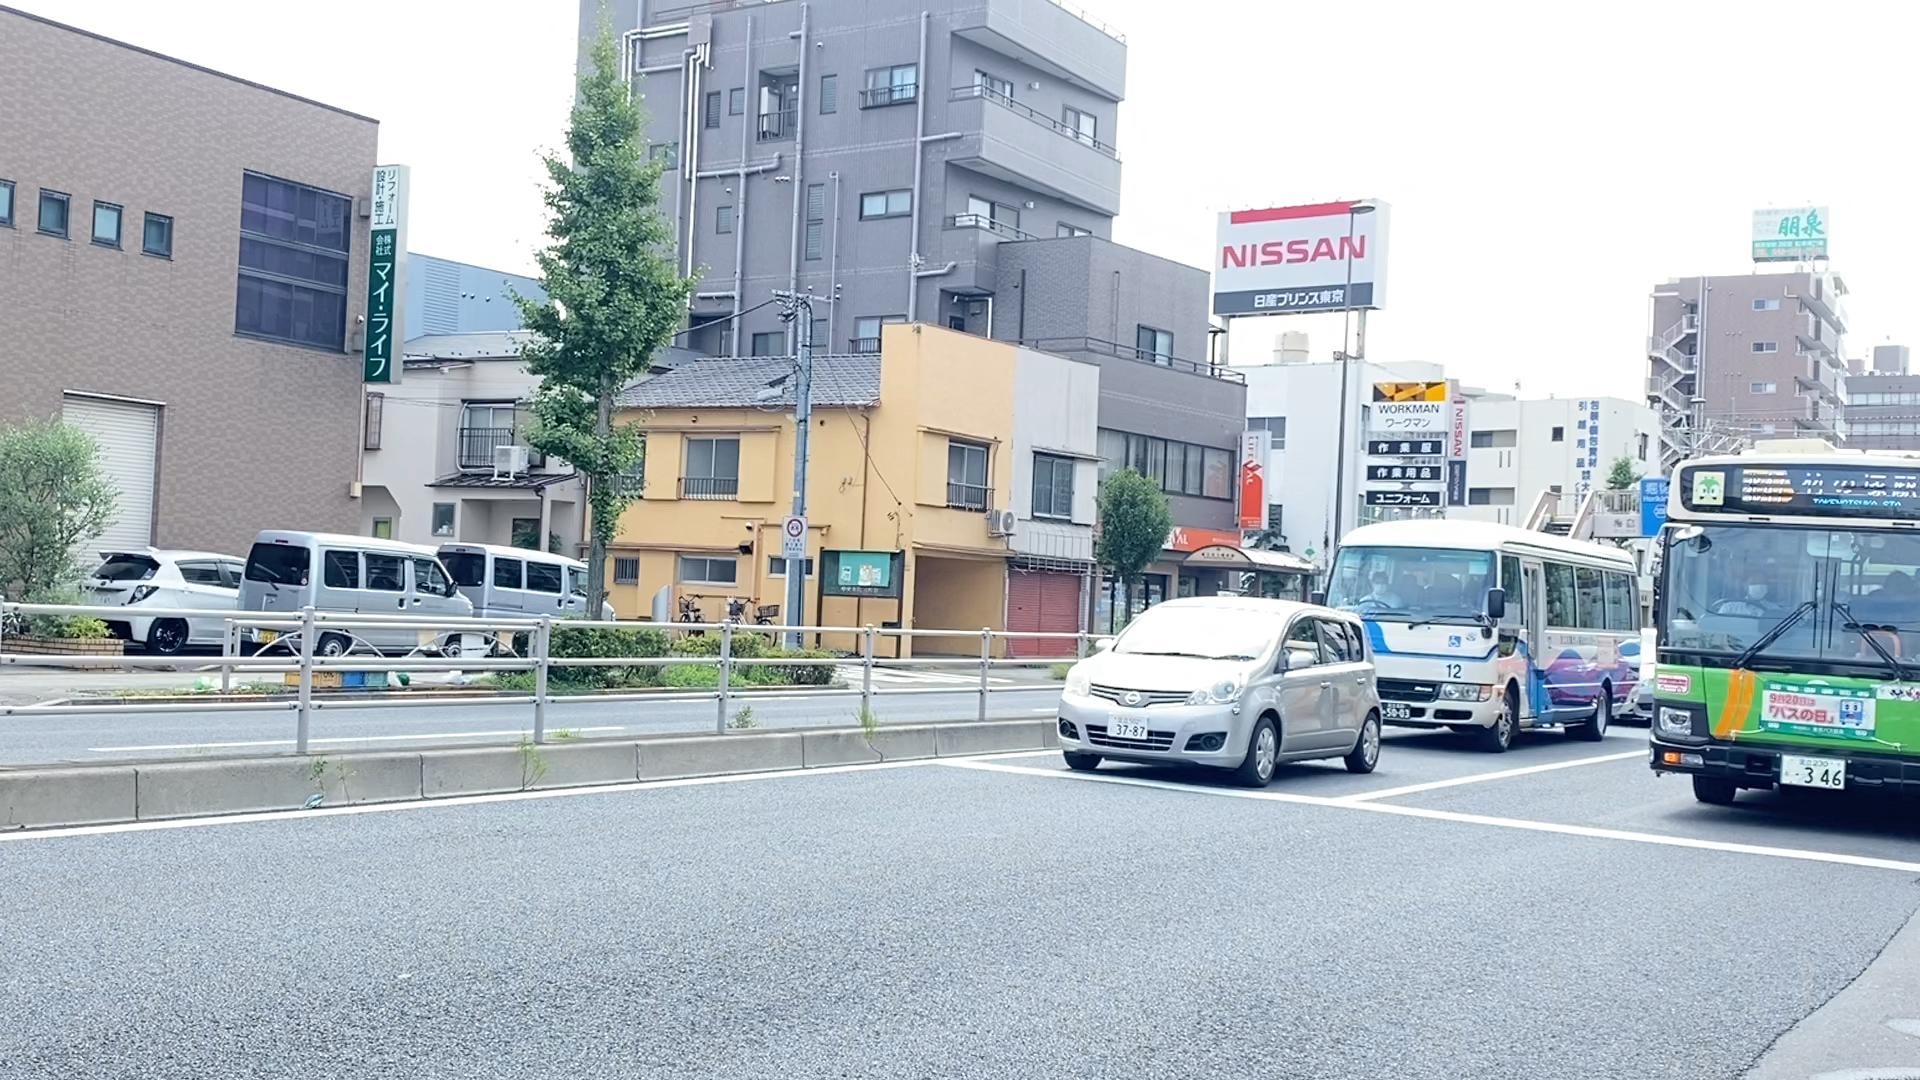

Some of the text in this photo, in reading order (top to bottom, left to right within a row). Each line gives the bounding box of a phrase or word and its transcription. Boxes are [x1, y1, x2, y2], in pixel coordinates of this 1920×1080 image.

[374, 169, 386, 225] 設計・施工
[385, 169, 396, 225] リフォーム
[1778, 208, 1825, 237] 朋泉
[1222, 235, 1365, 269] NISSAN
[1254, 289, 1344, 308] 日産プリンス東京
[369, 263, 392, 377] マイ・ライフ
[1379, 404, 1440, 414] WORKMAN
[1385, 418, 1431, 428] ワークマン
[1454, 408, 1463, 457] NISSAN
[1576, 401, 1587, 468] 引越用品
[1376, 467, 1431, 478] 作業用品
[1375, 494, 1431, 503] ユニフォーム
[1446, 663, 1462, 679] 12
[1768, 705, 1835, 725] 「バスの日」
[1116, 723, 1145, 737] 37-87
